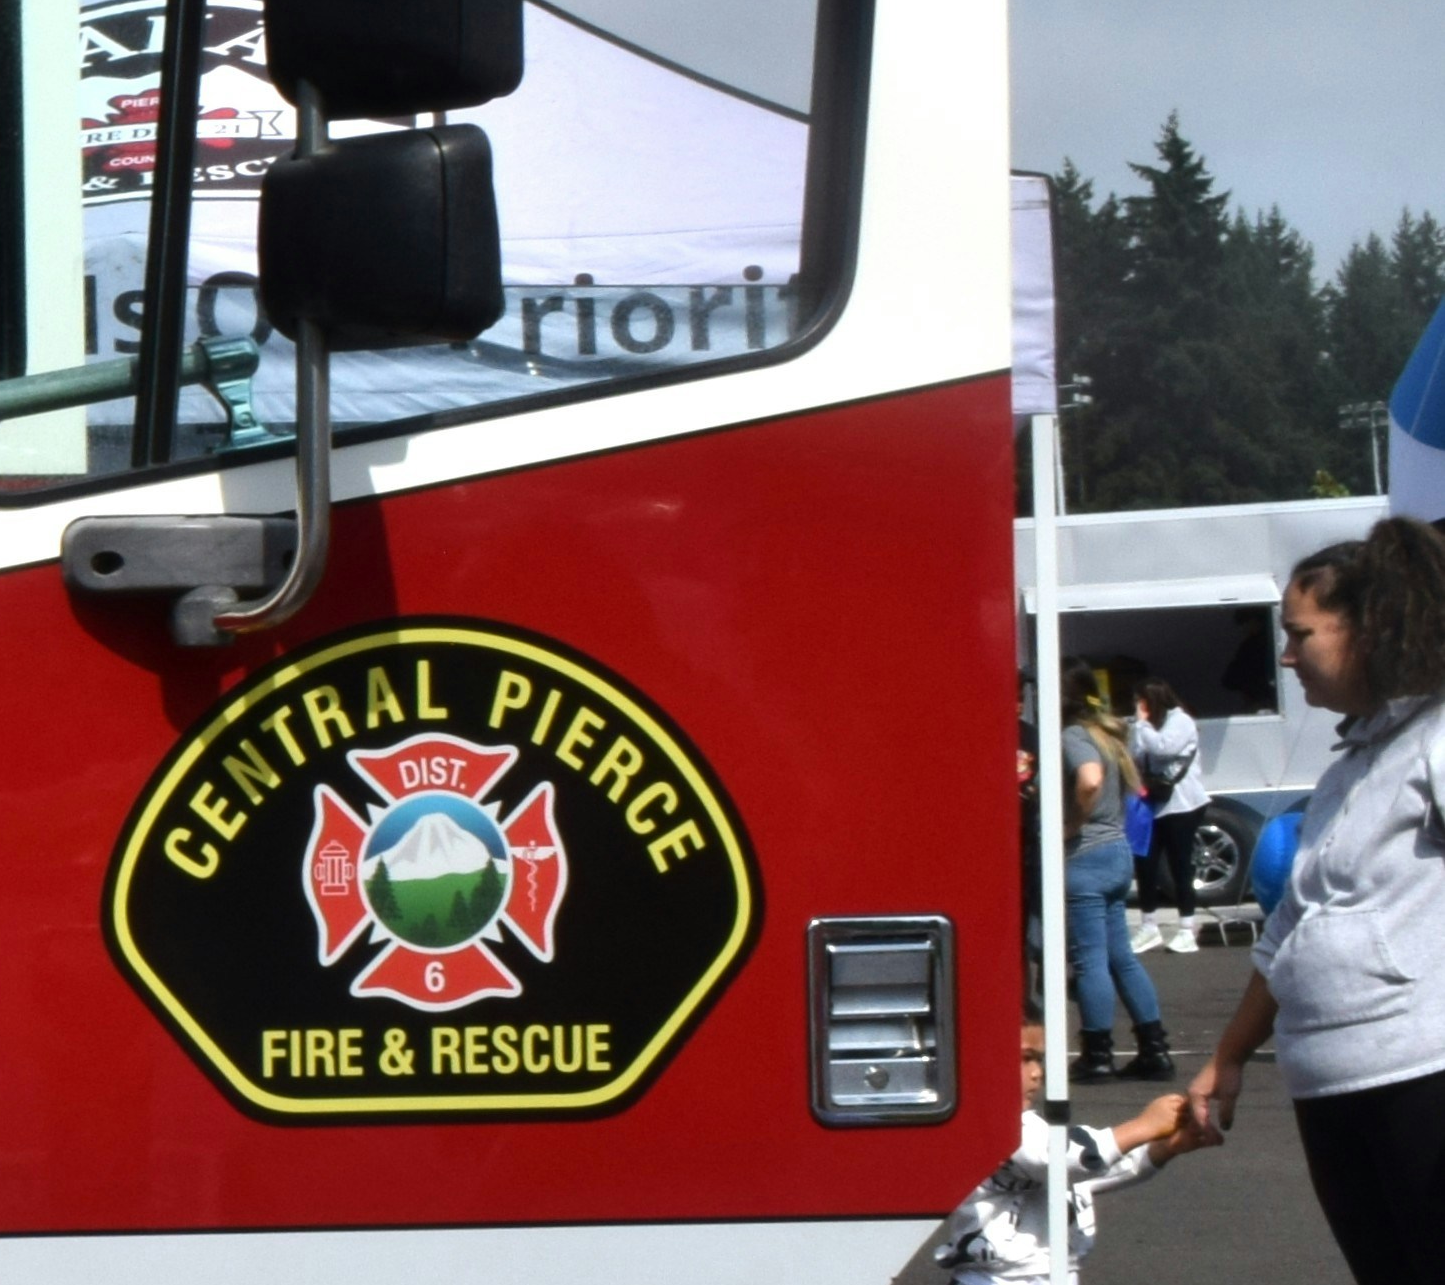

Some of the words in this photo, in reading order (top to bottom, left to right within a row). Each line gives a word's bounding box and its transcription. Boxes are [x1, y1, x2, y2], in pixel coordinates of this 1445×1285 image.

[120, 97, 160, 108] PIER
[109, 154, 156, 166] COUN
[164, 659, 449, 880] CENTRAL
[488, 669, 706, 874] PIERCE
[399, 756, 468, 790] DIST.
[423, 962, 446, 993] 6
[262, 1028, 364, 1077] FIRE
[379, 1028, 415, 1076] &
[431, 1023, 611, 1074] RESCUE
